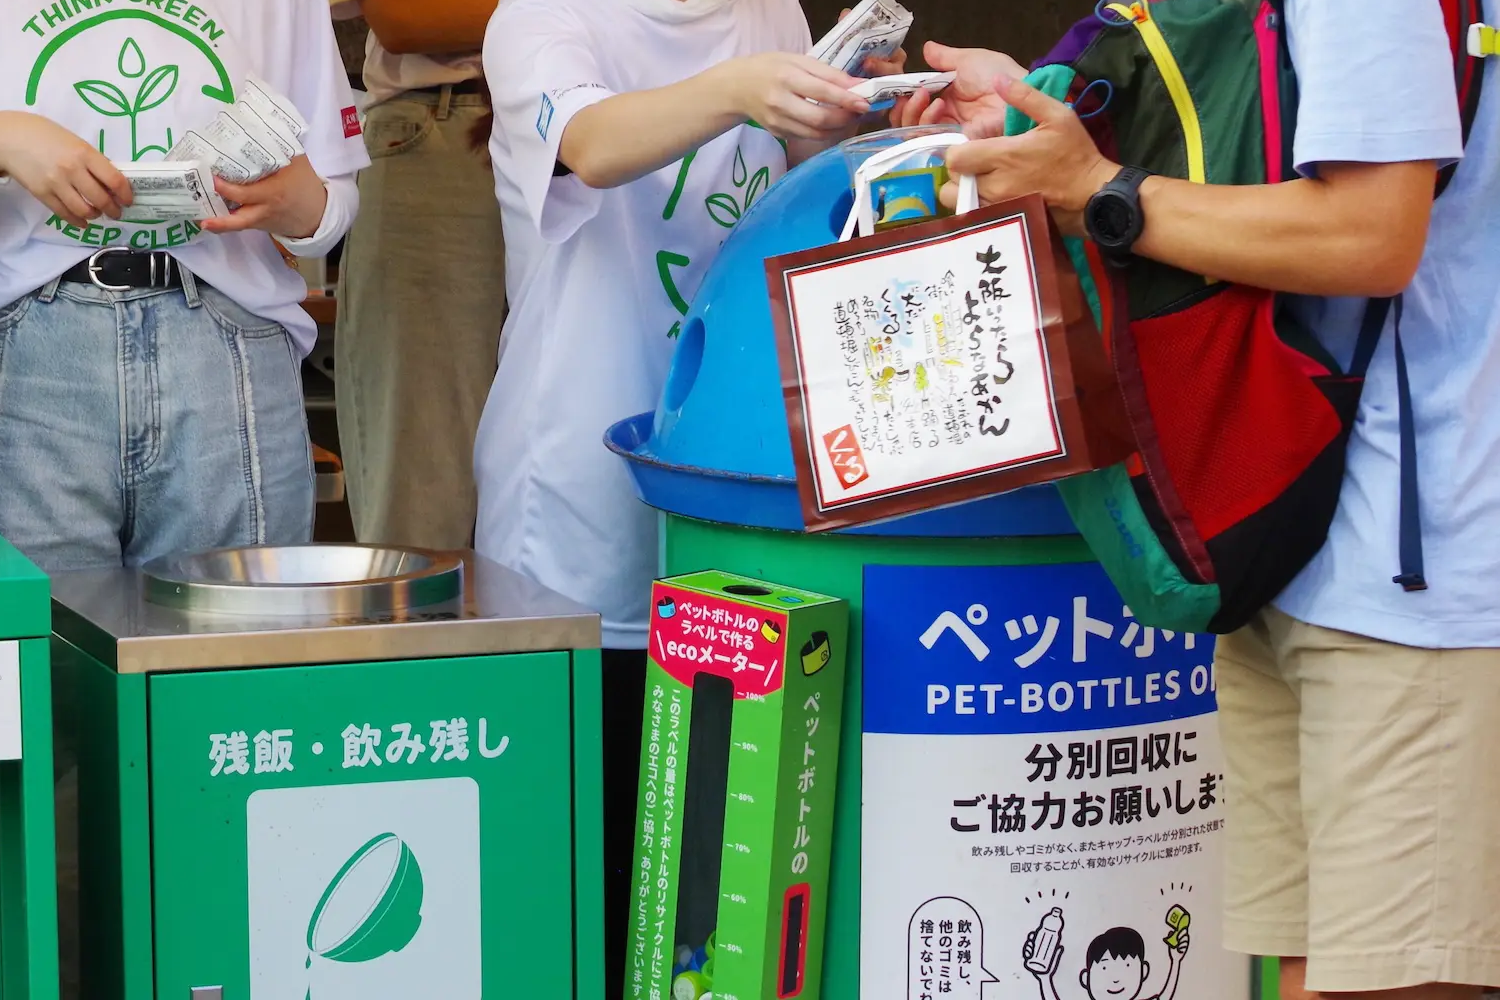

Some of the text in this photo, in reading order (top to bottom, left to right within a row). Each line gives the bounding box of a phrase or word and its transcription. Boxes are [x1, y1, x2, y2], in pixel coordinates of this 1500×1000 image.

[130, 220, 201, 249] CLEA
[679, 601, 759, 633] ペットボトルの
[681, 619, 754, 651] ラベルで作る
[919, 596, 1196, 668] ペット
[926, 669, 1180, 714] PET-BOTTLES
[209, 717, 510, 777] 残飯・飲み残し
[1025, 731, 1197, 783] 分別回収に
[738, 793, 754, 803] 80%
[791, 692, 821, 874] ペットボトルの
[632, 685, 664, 1000] みなさまのエコへのご協力、ありがとうございます
[735, 843, 750, 853] 70%
[731, 893, 746, 904] 60%
[727, 943, 742, 954] 50%
[939, 919, 953, 993] 他のゴミは
[957, 919, 972, 985] 飲み残し、
